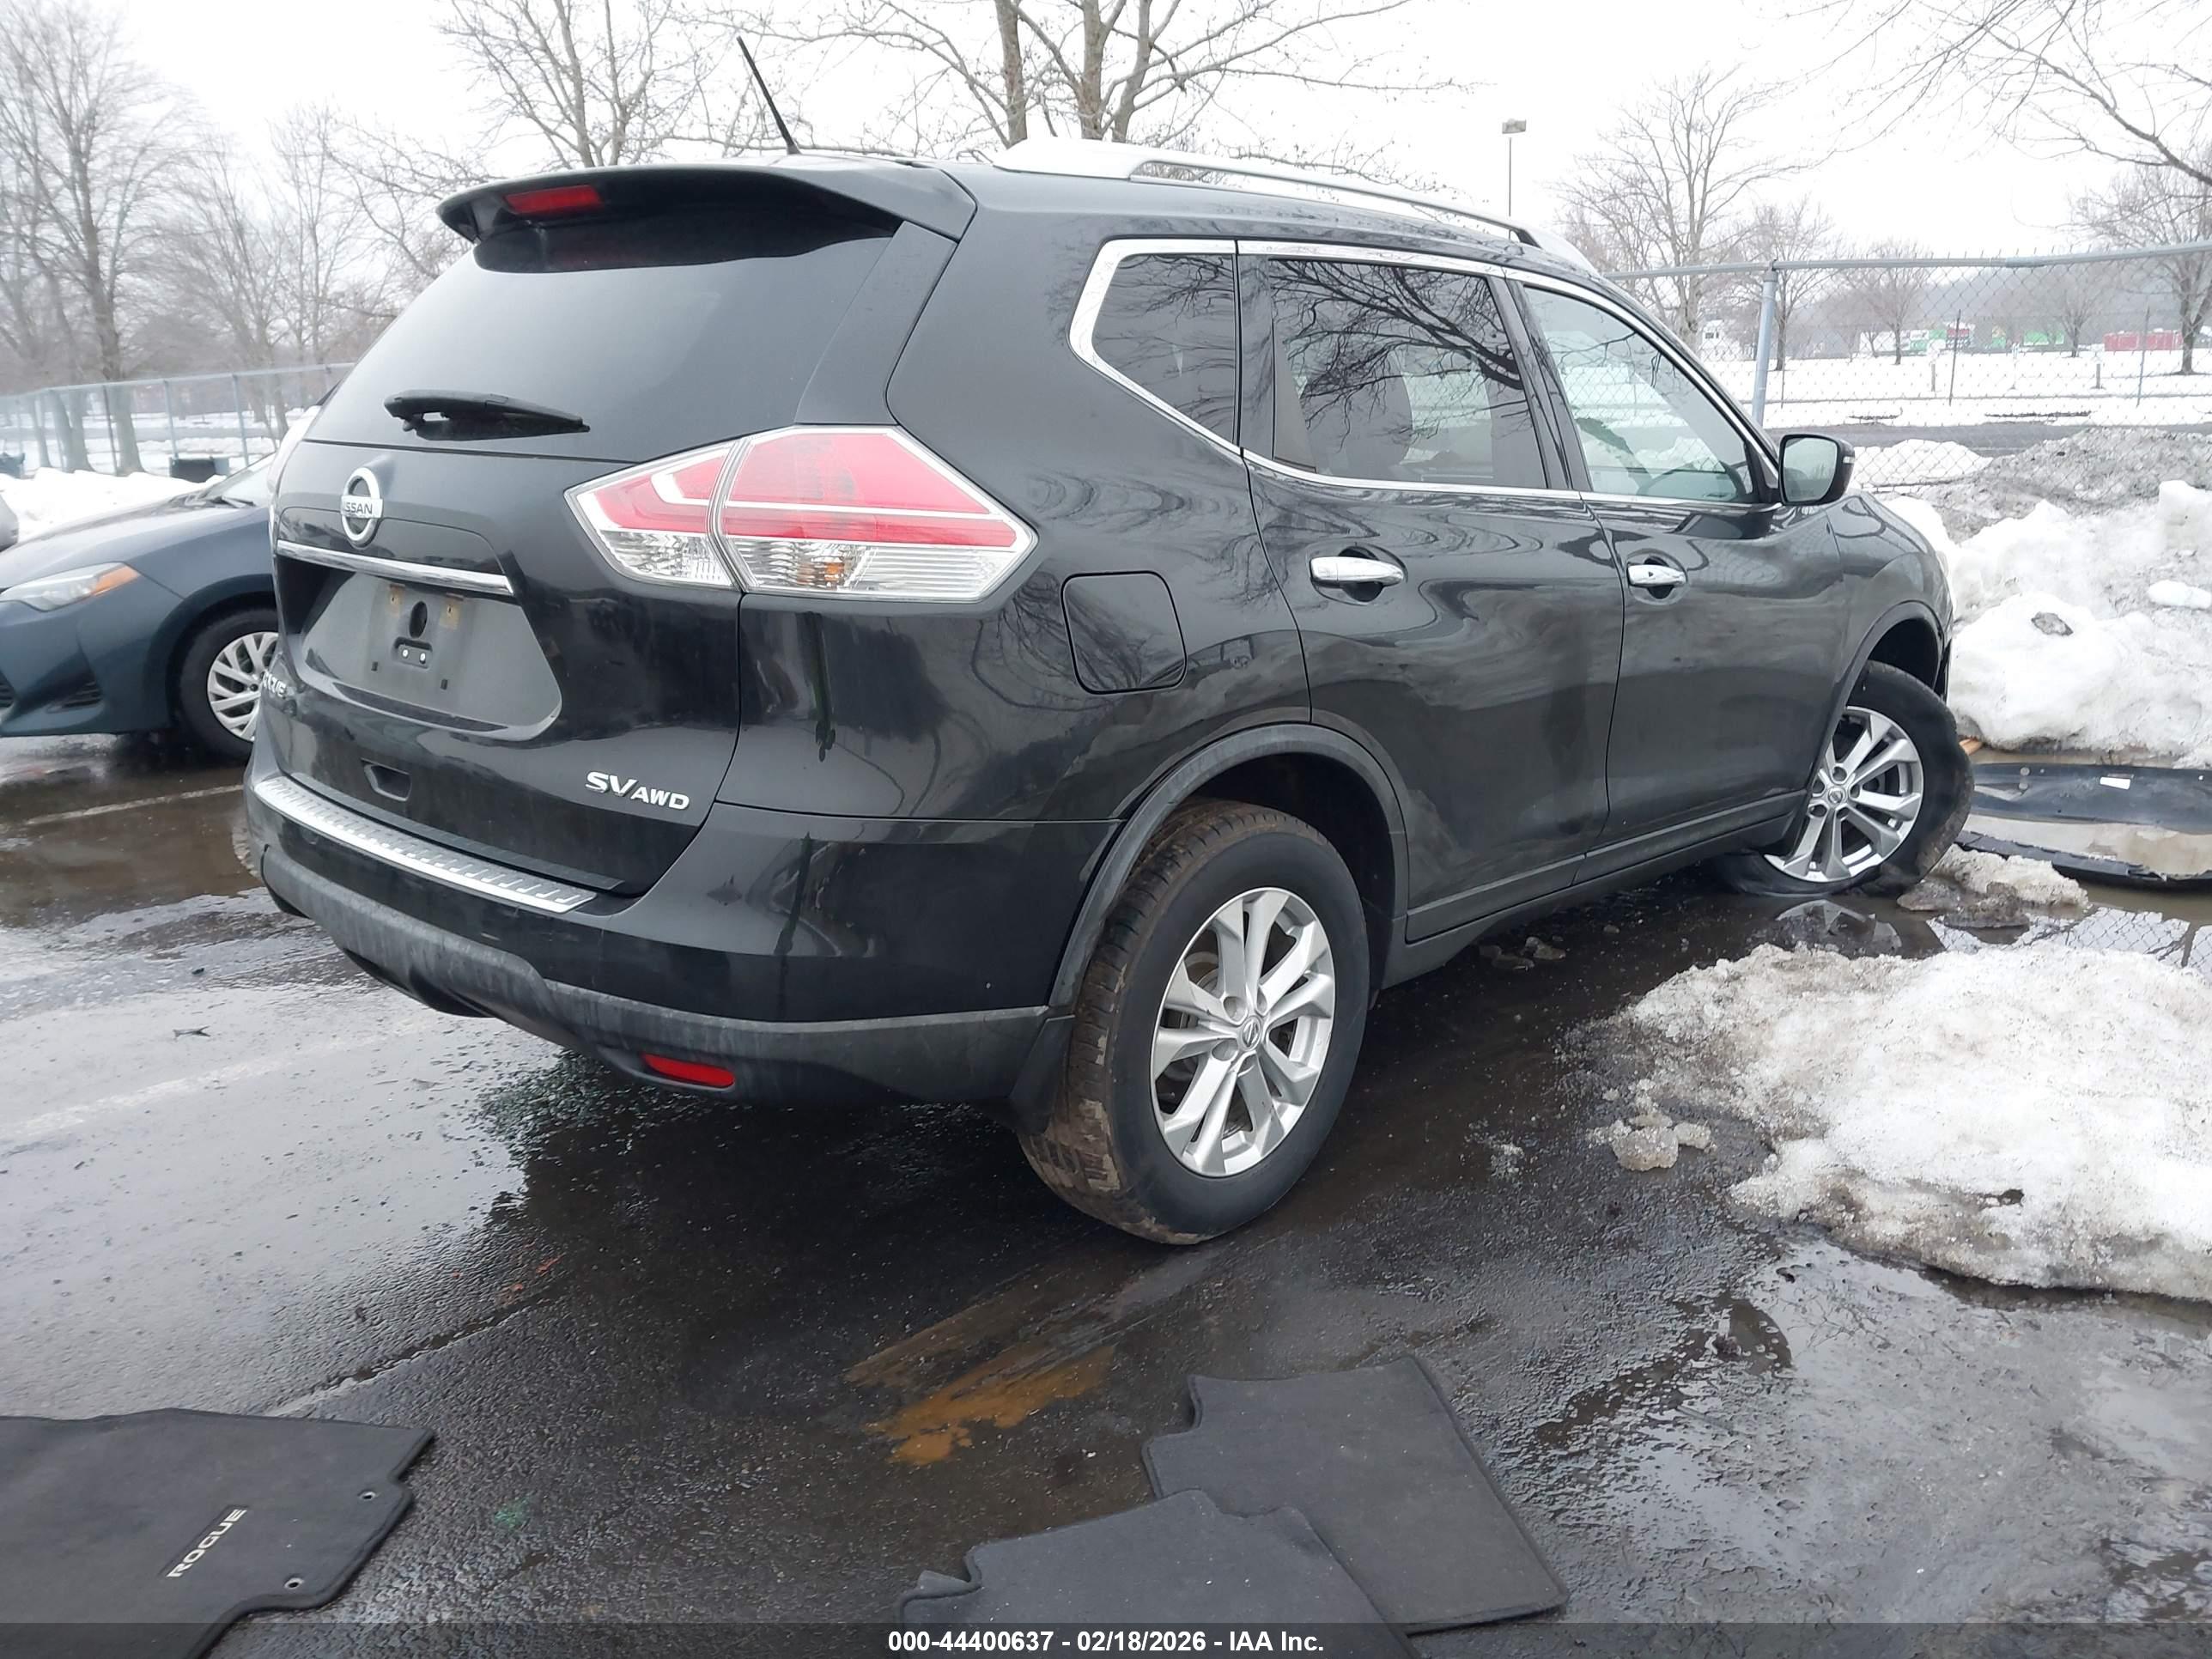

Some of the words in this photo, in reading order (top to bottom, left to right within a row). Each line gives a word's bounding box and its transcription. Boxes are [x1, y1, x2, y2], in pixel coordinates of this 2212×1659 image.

[585, 771, 638, 797] SV
[630, 786, 690, 810] AWD
[166, 1509, 247, 1577] ROGUE
